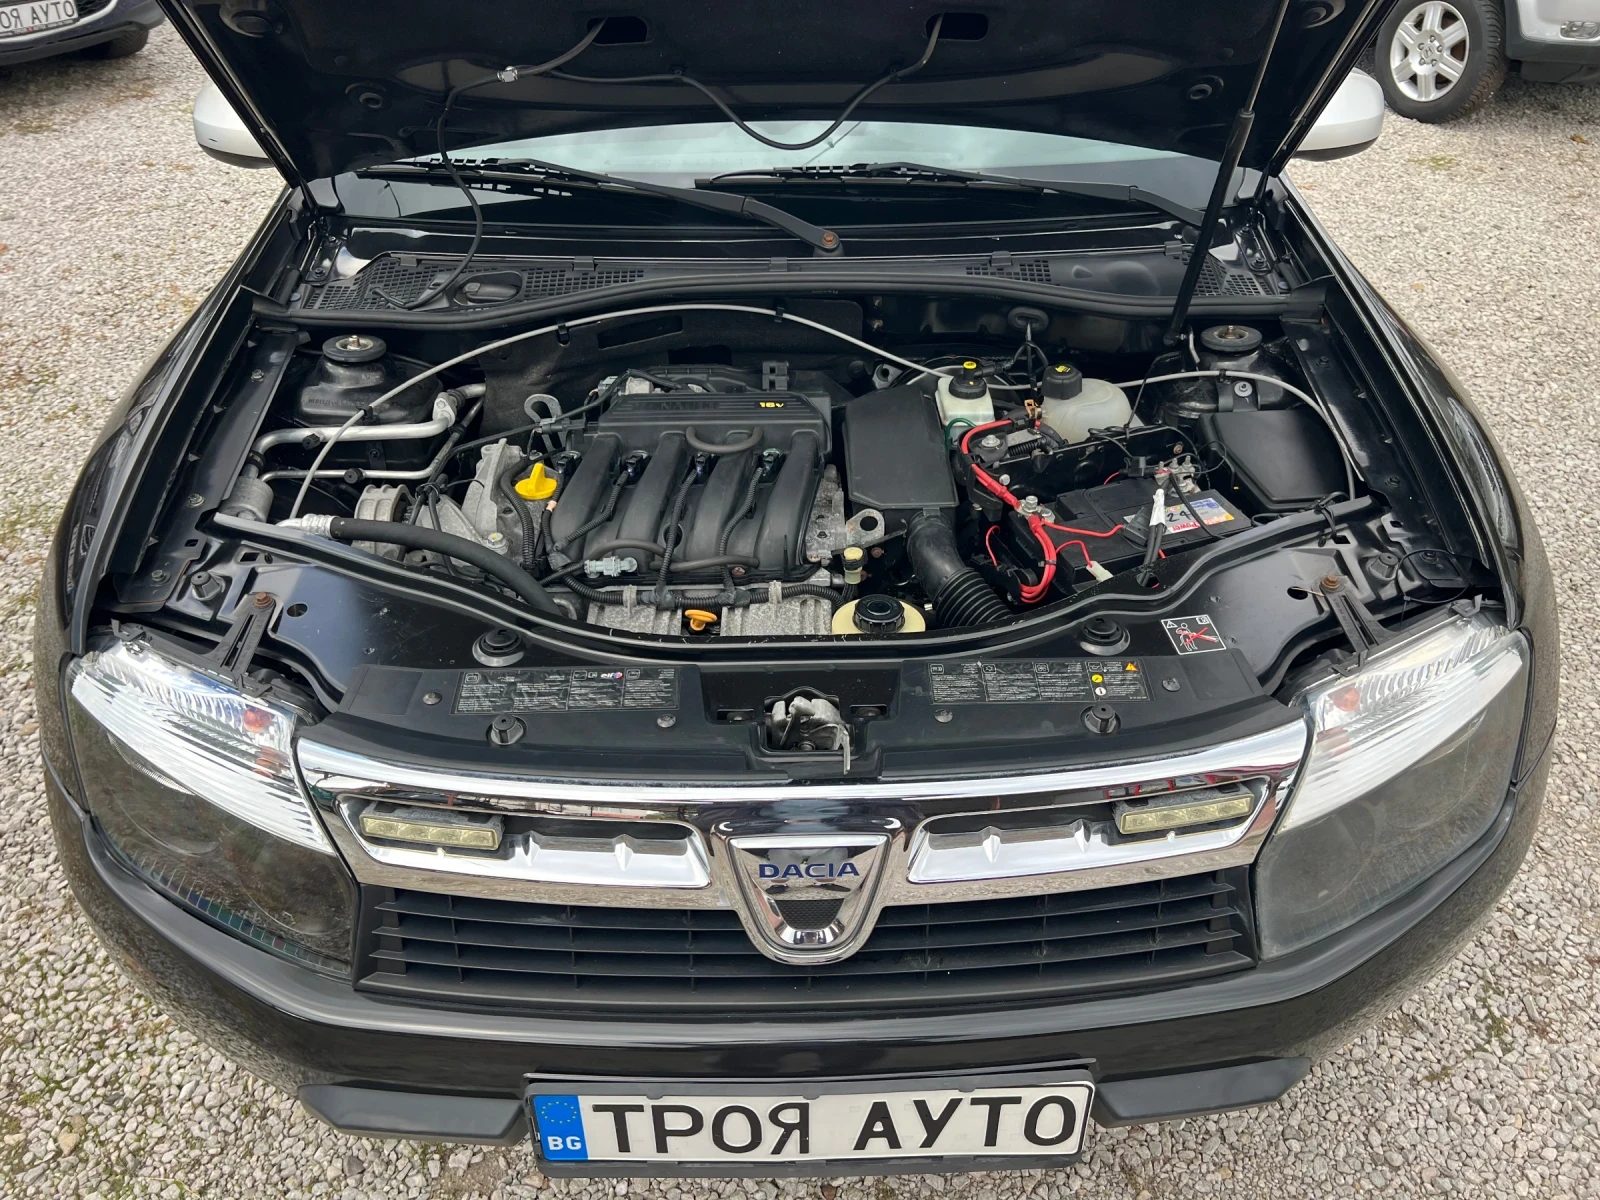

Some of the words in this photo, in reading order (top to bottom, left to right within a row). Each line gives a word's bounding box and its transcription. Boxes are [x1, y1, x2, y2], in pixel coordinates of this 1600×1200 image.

[31, 0, 75, 24] АУТО
[758, 862, 860, 879] DACIA
[592, 1102, 810, 1155] ТРОЯ
[853, 1095, 1077, 1150] АУТО
[547, 1136, 582, 1151] BG
